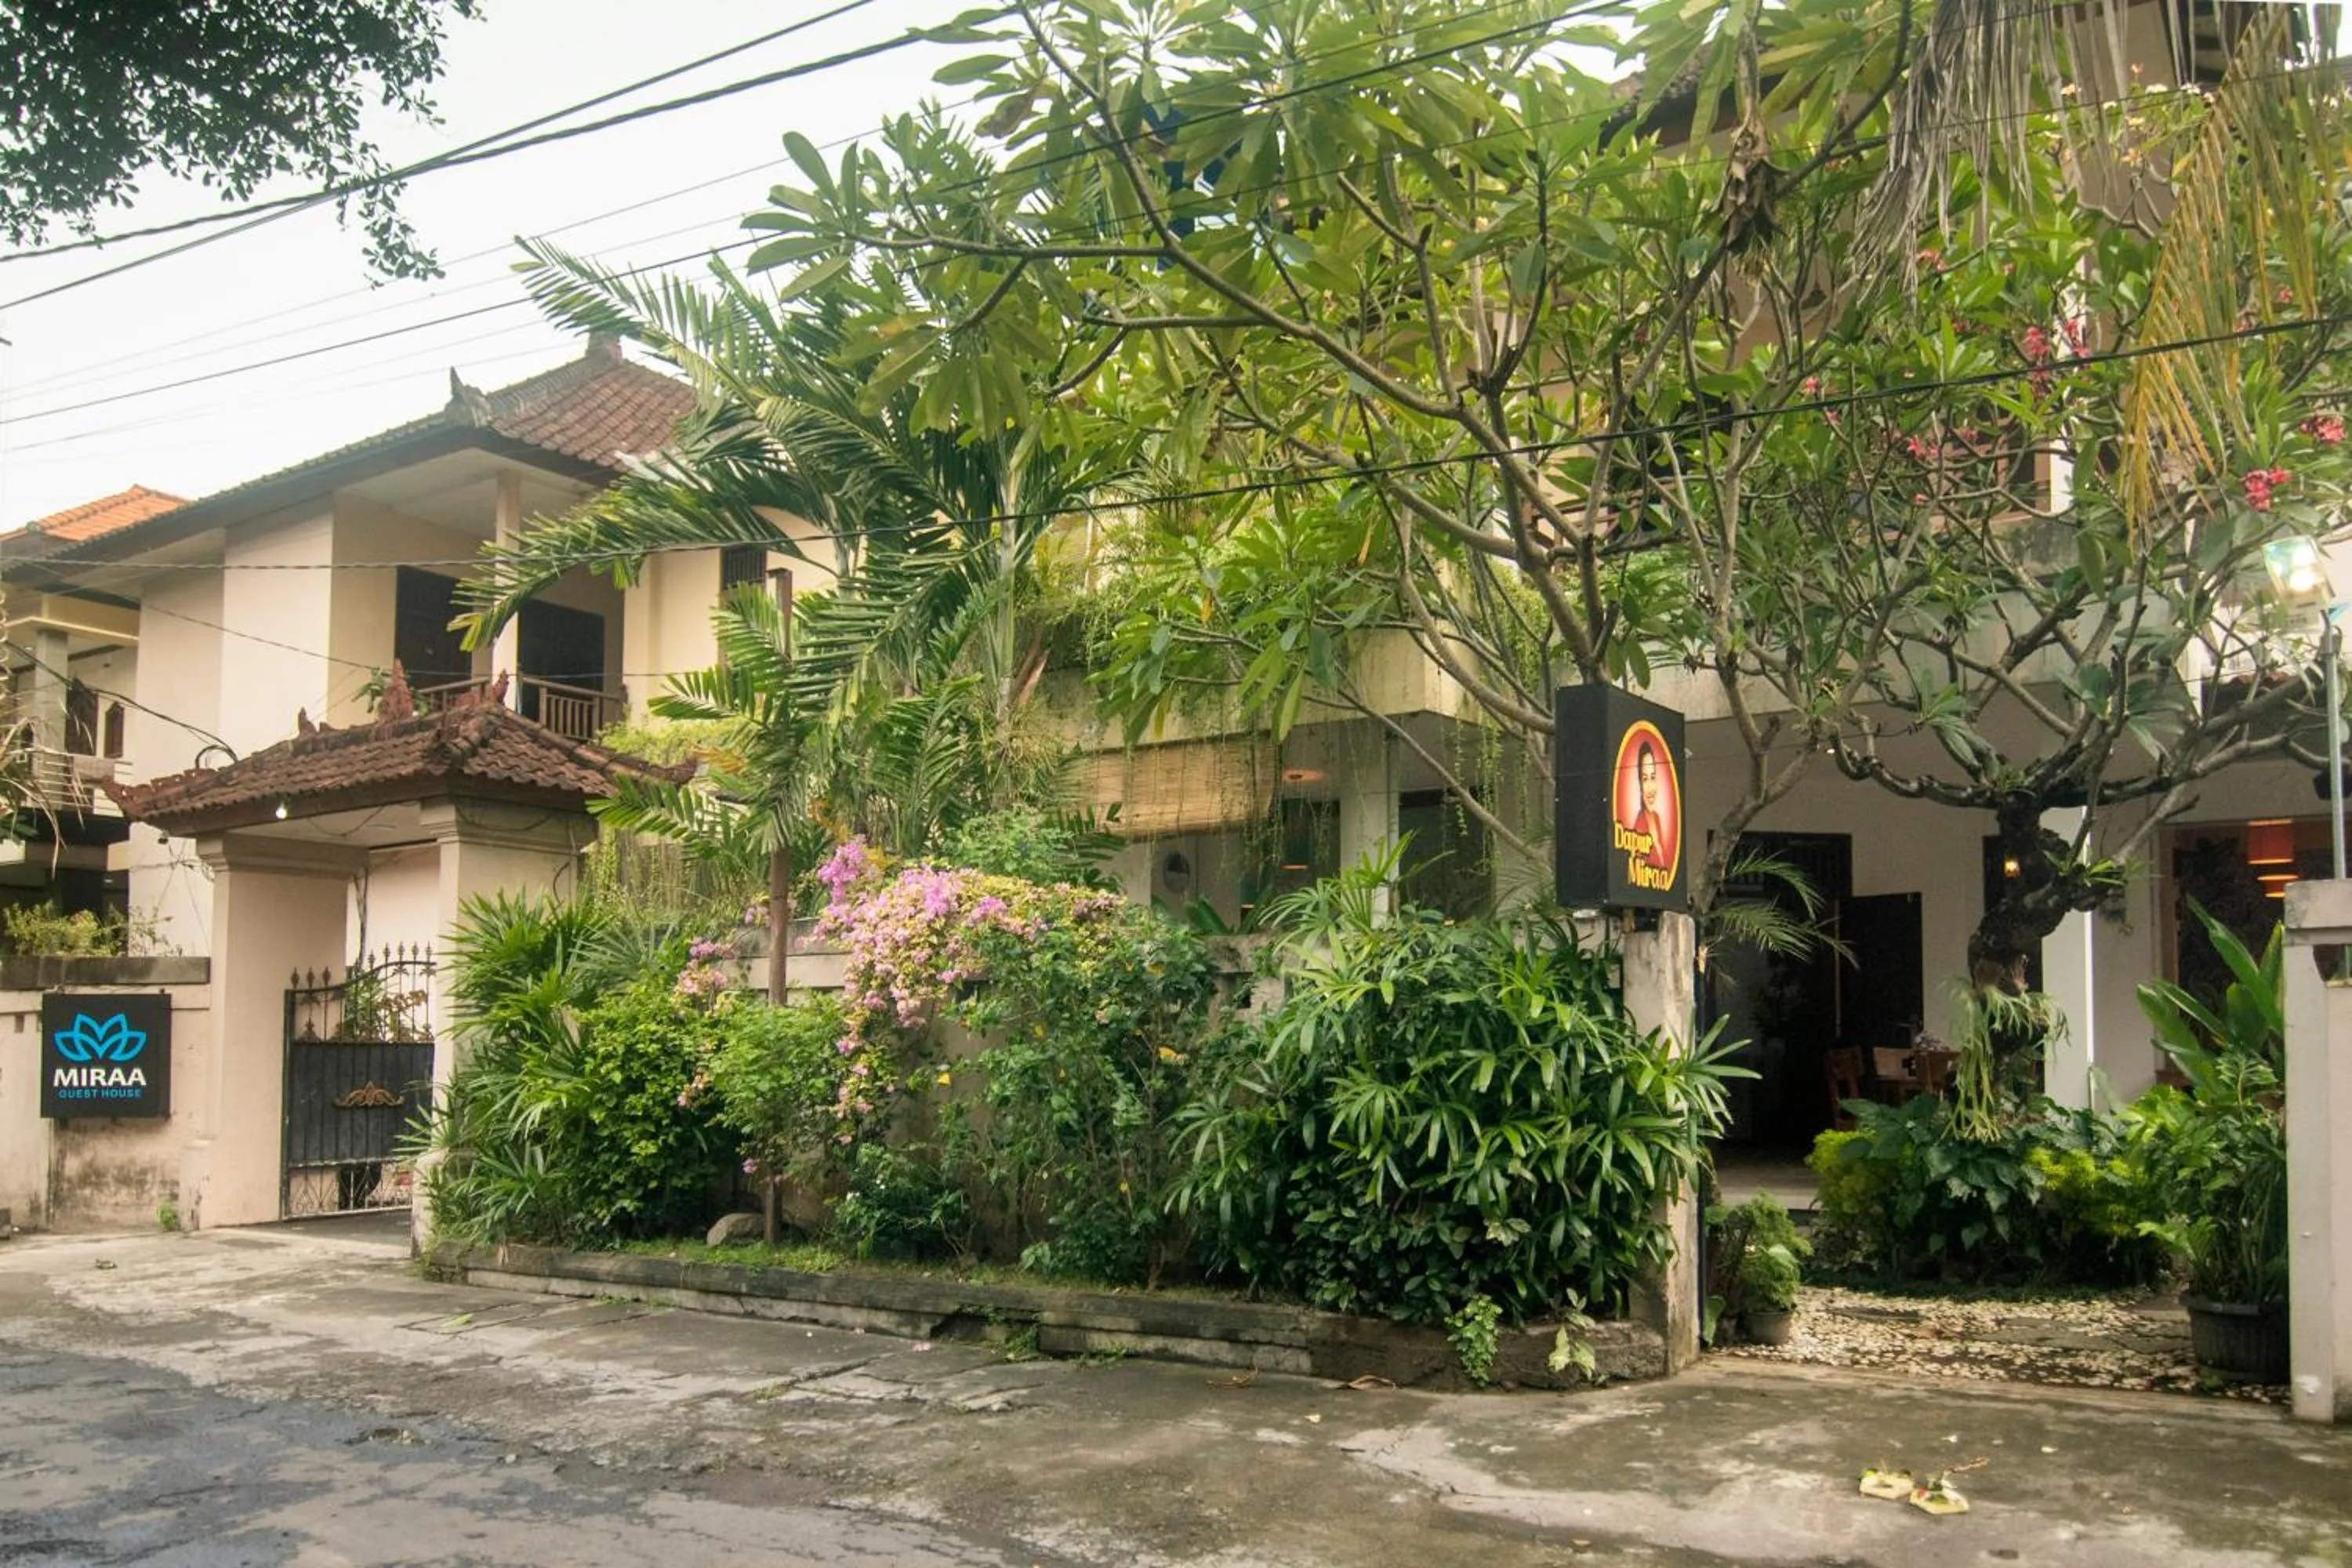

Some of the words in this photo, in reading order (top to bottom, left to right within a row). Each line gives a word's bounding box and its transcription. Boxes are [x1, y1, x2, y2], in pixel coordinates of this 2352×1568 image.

[1615, 822, 1653, 858] Dapur
[1628, 856, 1670, 891] Miraa
[53, 1067, 147, 1087] MIRAA
[59, 1088, 97, 1098] GUEST
[101, 1088, 141, 1098] HOUSE
